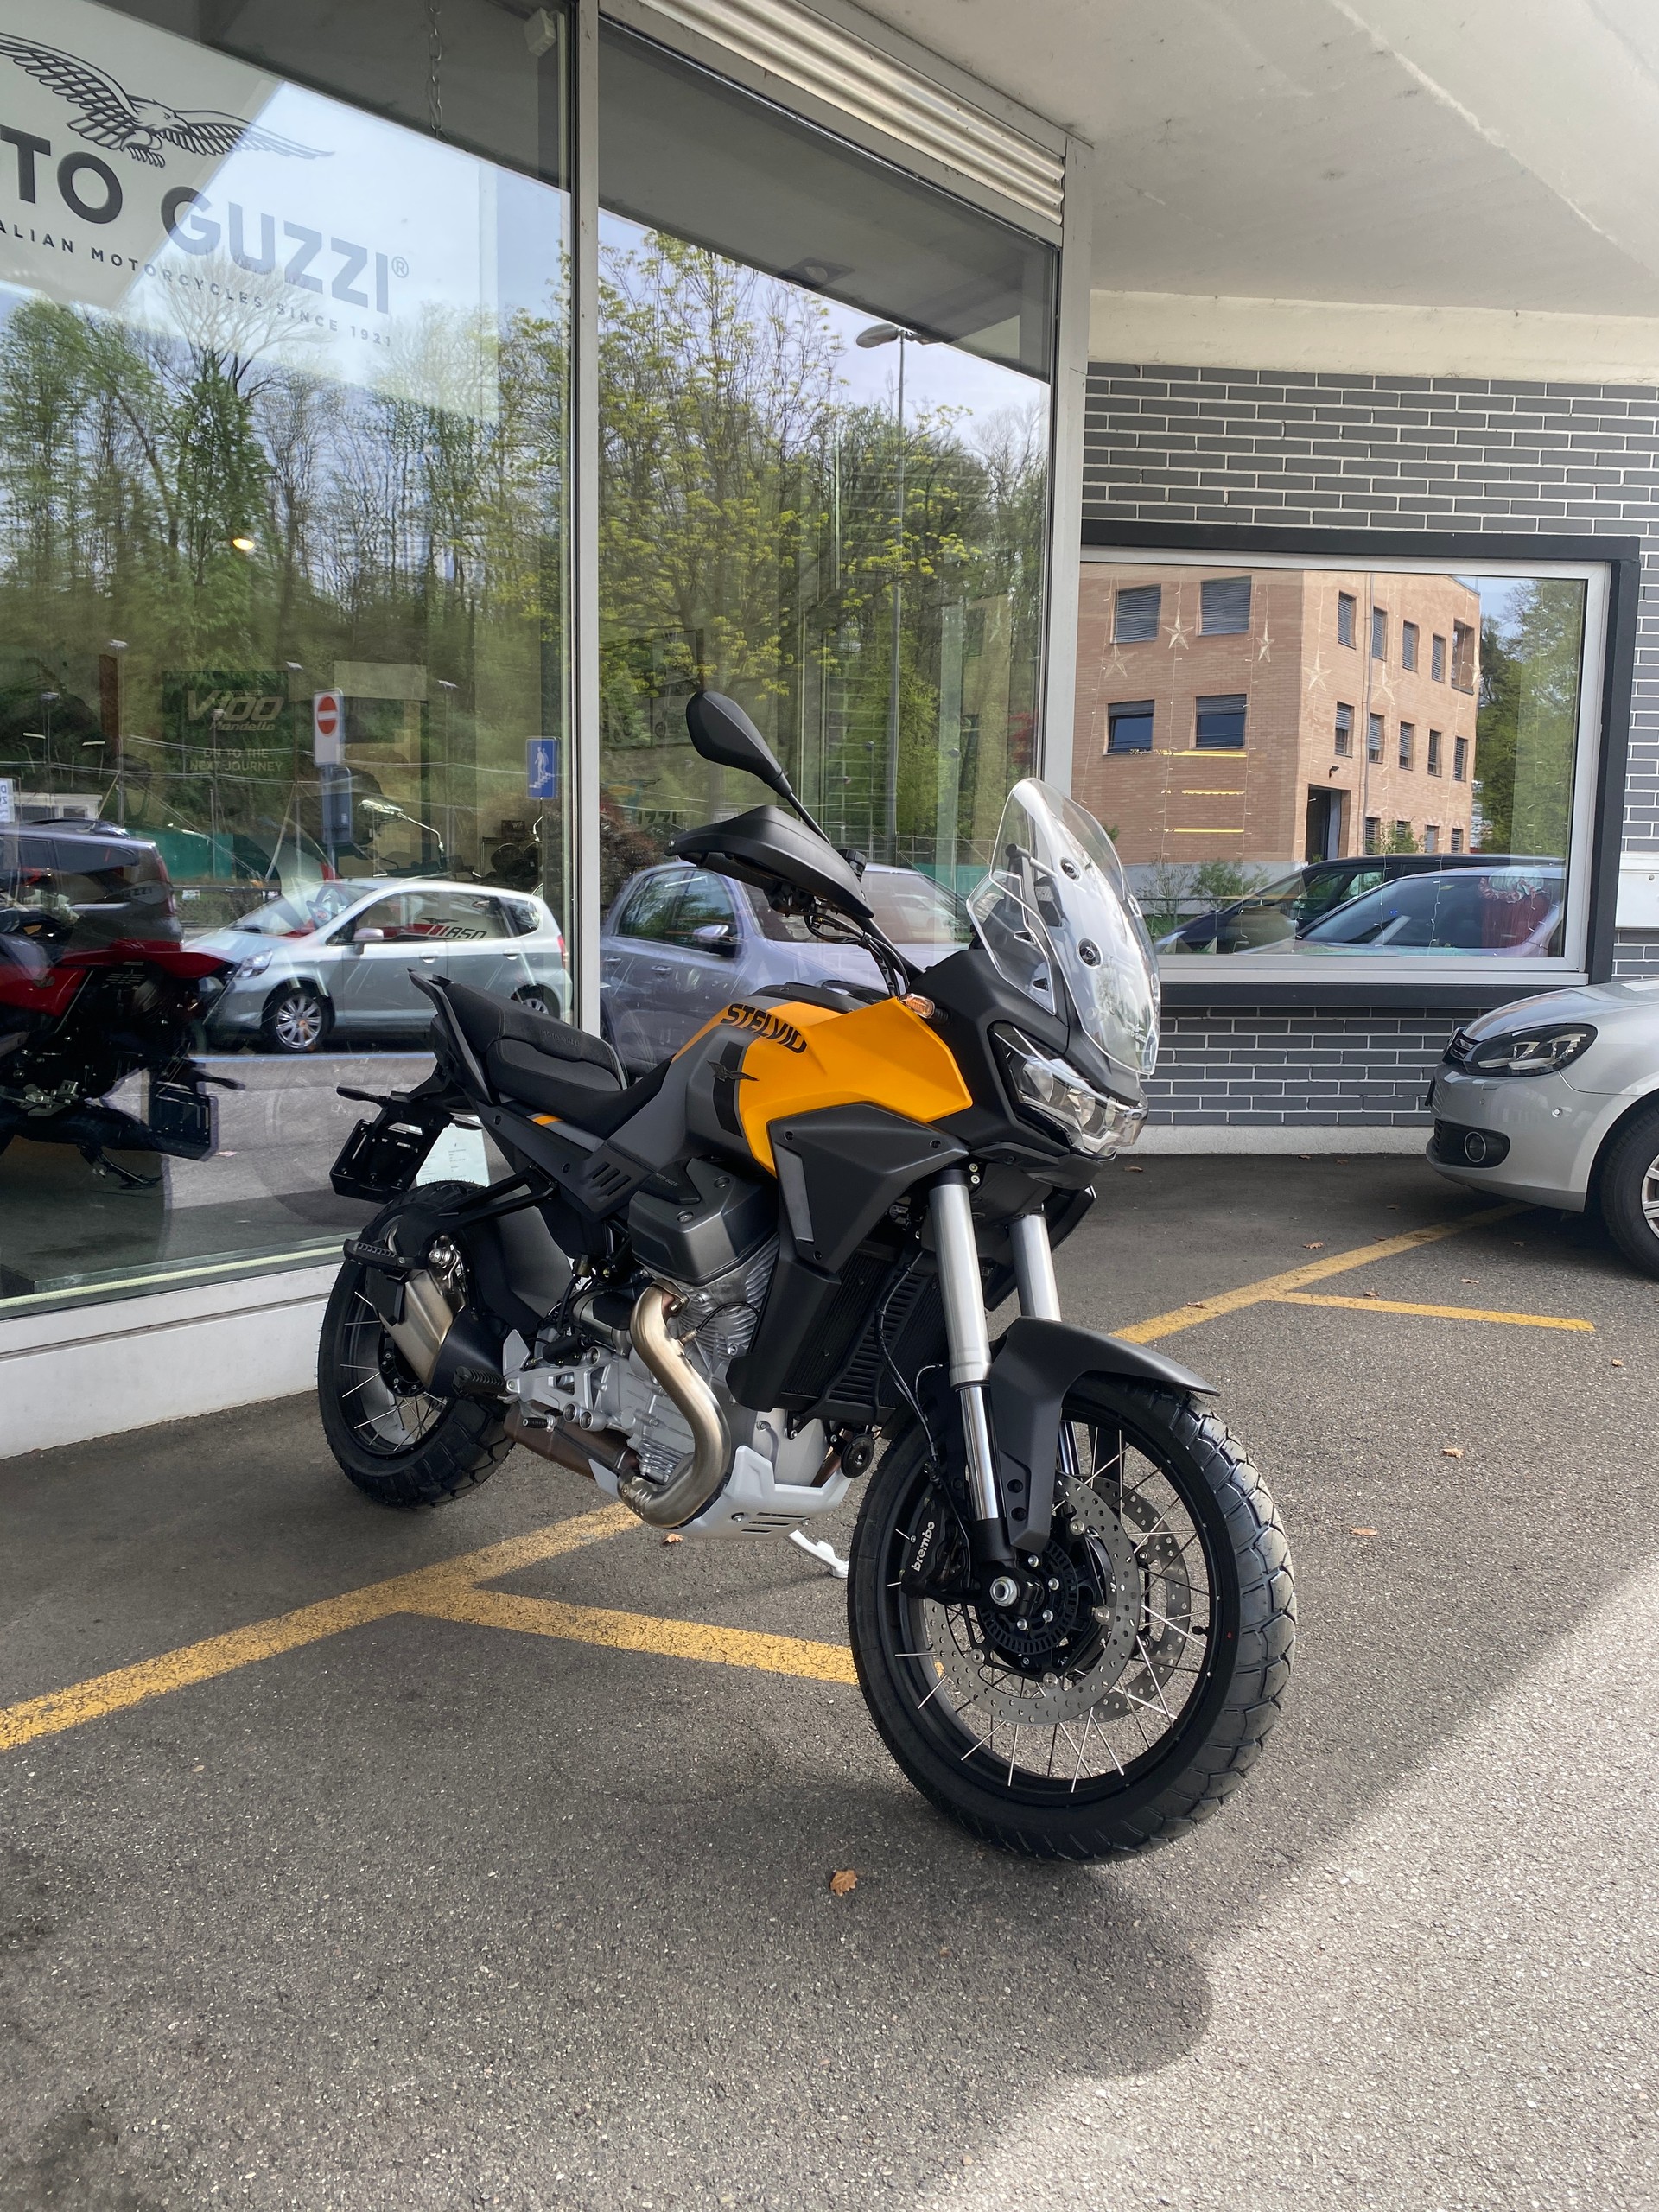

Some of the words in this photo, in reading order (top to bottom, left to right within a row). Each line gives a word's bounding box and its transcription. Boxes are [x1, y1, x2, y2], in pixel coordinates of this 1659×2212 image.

[91, 247, 262, 308] MOTORCYCLES
[276, 302, 338, 332] SINCE
[350, 325, 391, 347] 1921
[190, 761, 220, 771] NEXT
[225, 761, 283, 772] JOURNEY
[245, 748, 269, 759] THE
[720, 1003, 808, 1054] STELVIO
[911, 1521, 935, 1572] brembo
